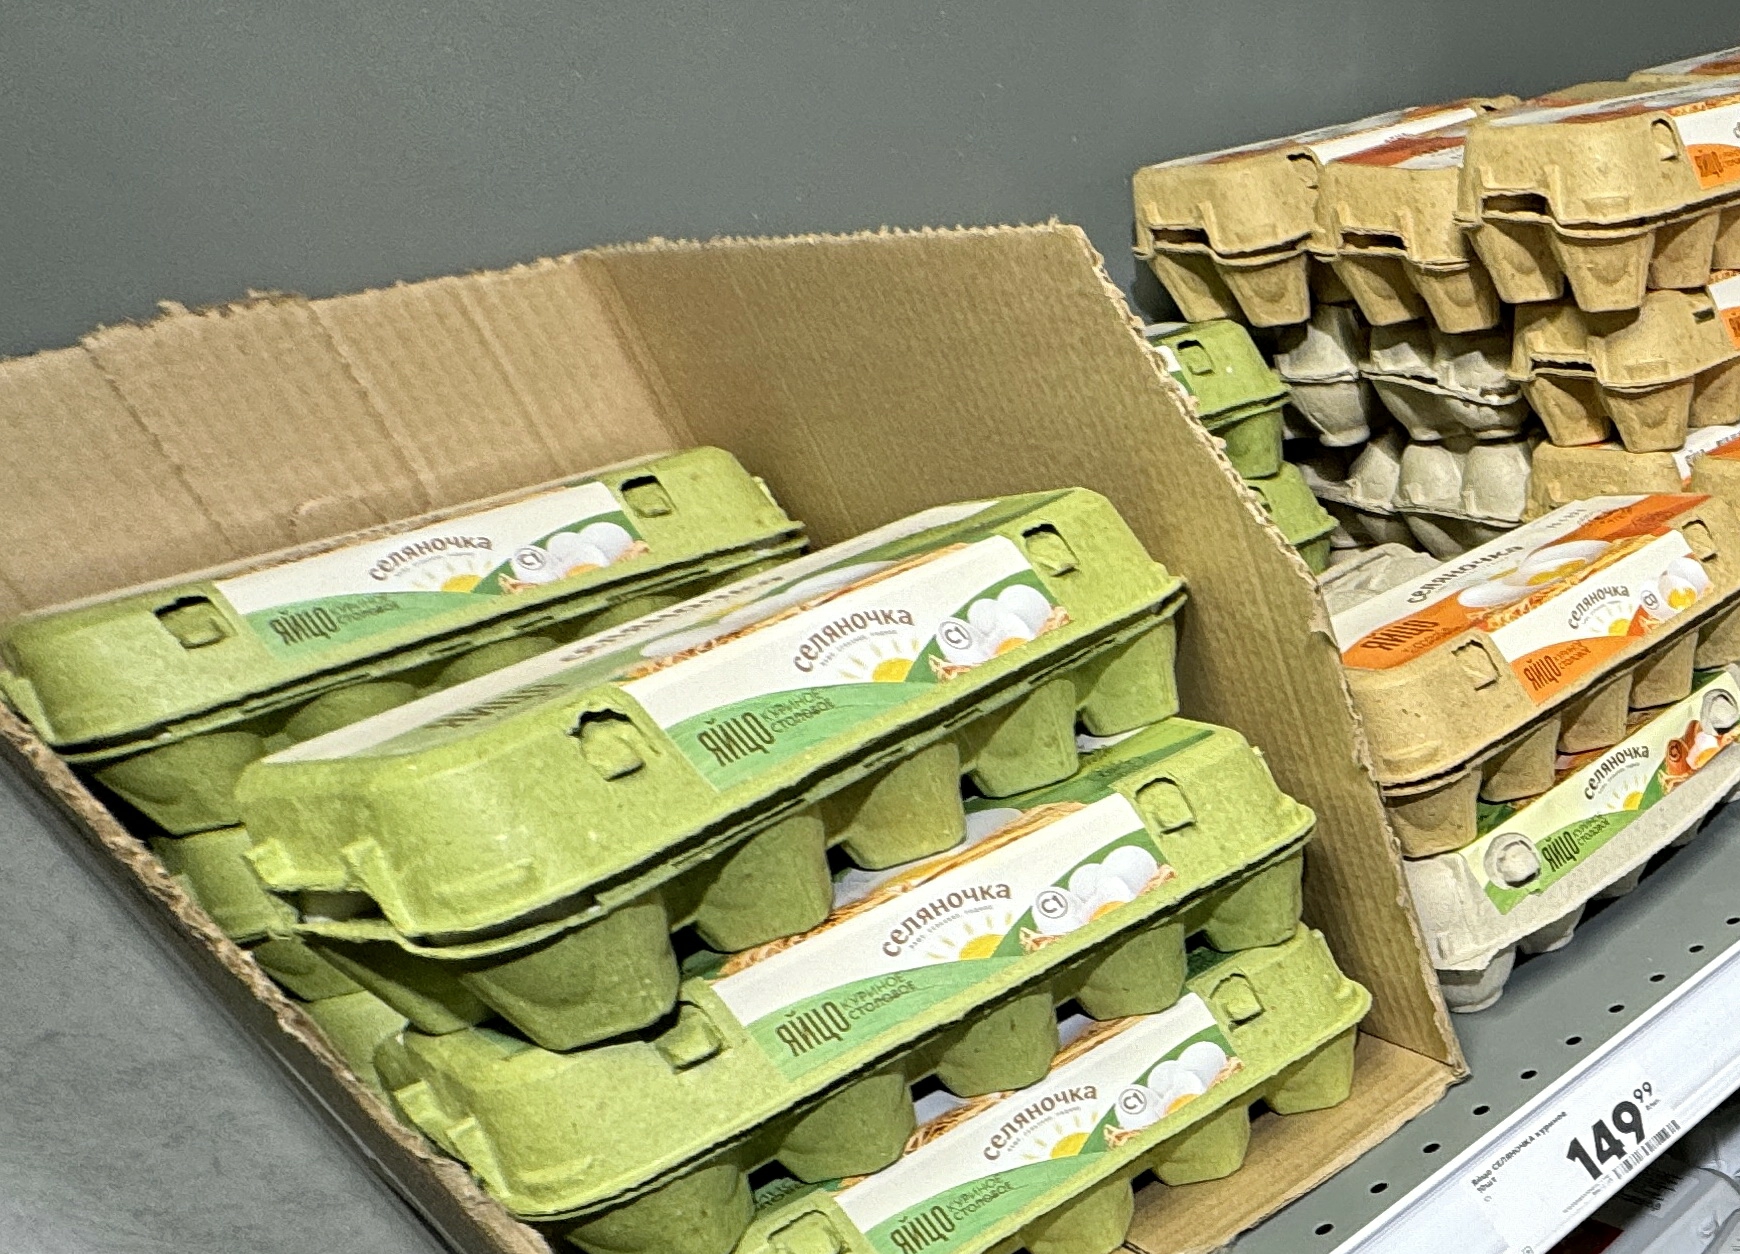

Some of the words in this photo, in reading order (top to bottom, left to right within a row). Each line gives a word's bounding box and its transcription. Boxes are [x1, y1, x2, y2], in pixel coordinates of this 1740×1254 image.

[368, 533, 495, 581] селяночка
[268, 606, 341, 647] ЯЙЦО
[1568, 585, 1629, 630] селяночка
[792, 607, 916, 673] селяночка
[1523, 657, 1562, 691] ЯЙЦО
[697, 708, 775, 767] ЯЙЦО
[1584, 745, 1650, 800] селяночка
[1542, 835, 1581, 873] ЯЙЦО
[882, 882, 1012, 958] селяночка
[842, 971, 905, 1009] КУРИНОЕ
[847, 979, 917, 1021] СТОЛОВОЕ
[775, 1000, 852, 1058] ЯЙЦО
[983, 1084, 1098, 1161] селяночка
[1566, 1101, 1646, 1180] 149
[1633, 1081, 1653, 1103] 99
